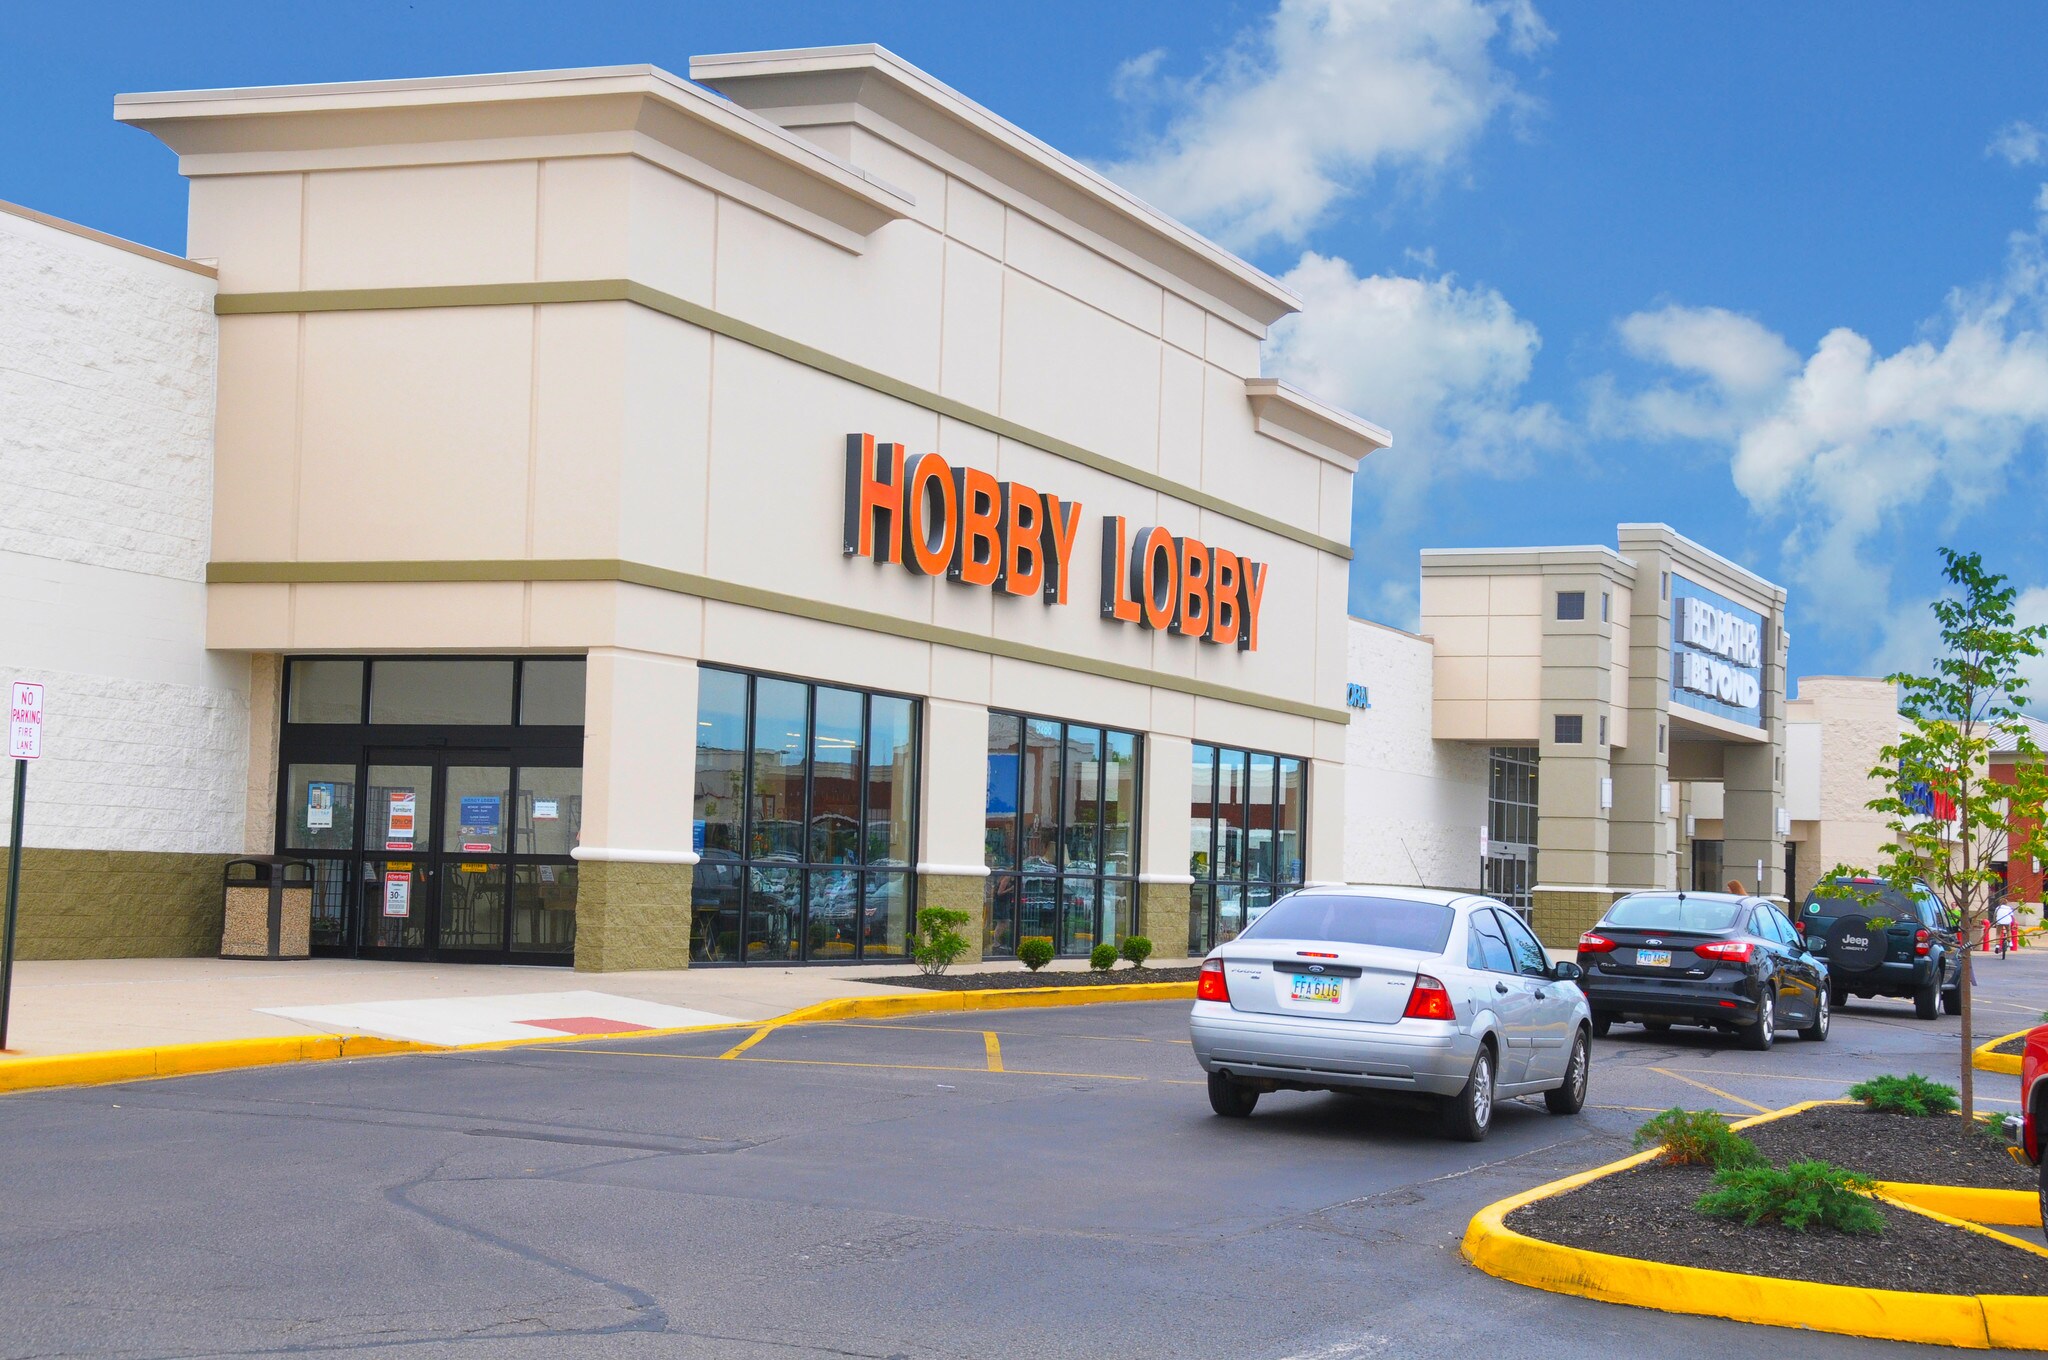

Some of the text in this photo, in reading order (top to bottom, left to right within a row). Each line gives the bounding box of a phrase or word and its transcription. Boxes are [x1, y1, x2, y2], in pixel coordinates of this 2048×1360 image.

[844, 433, 1267, 651] HOBBY LOBBY
[1676, 597, 1717, 651] BED
[1717, 609, 1750, 665] BATH
[1676, 652, 1760, 709] BEYOND
[21, 692, 33, 705] NO
[12, 708, 41, 724] PARKING
[18, 727, 32, 737] FIRE
[16, 740, 33, 750] LANE
[1842, 934, 1869, 946] Jeep
[1294, 980, 1338, 997] FFA 6116
